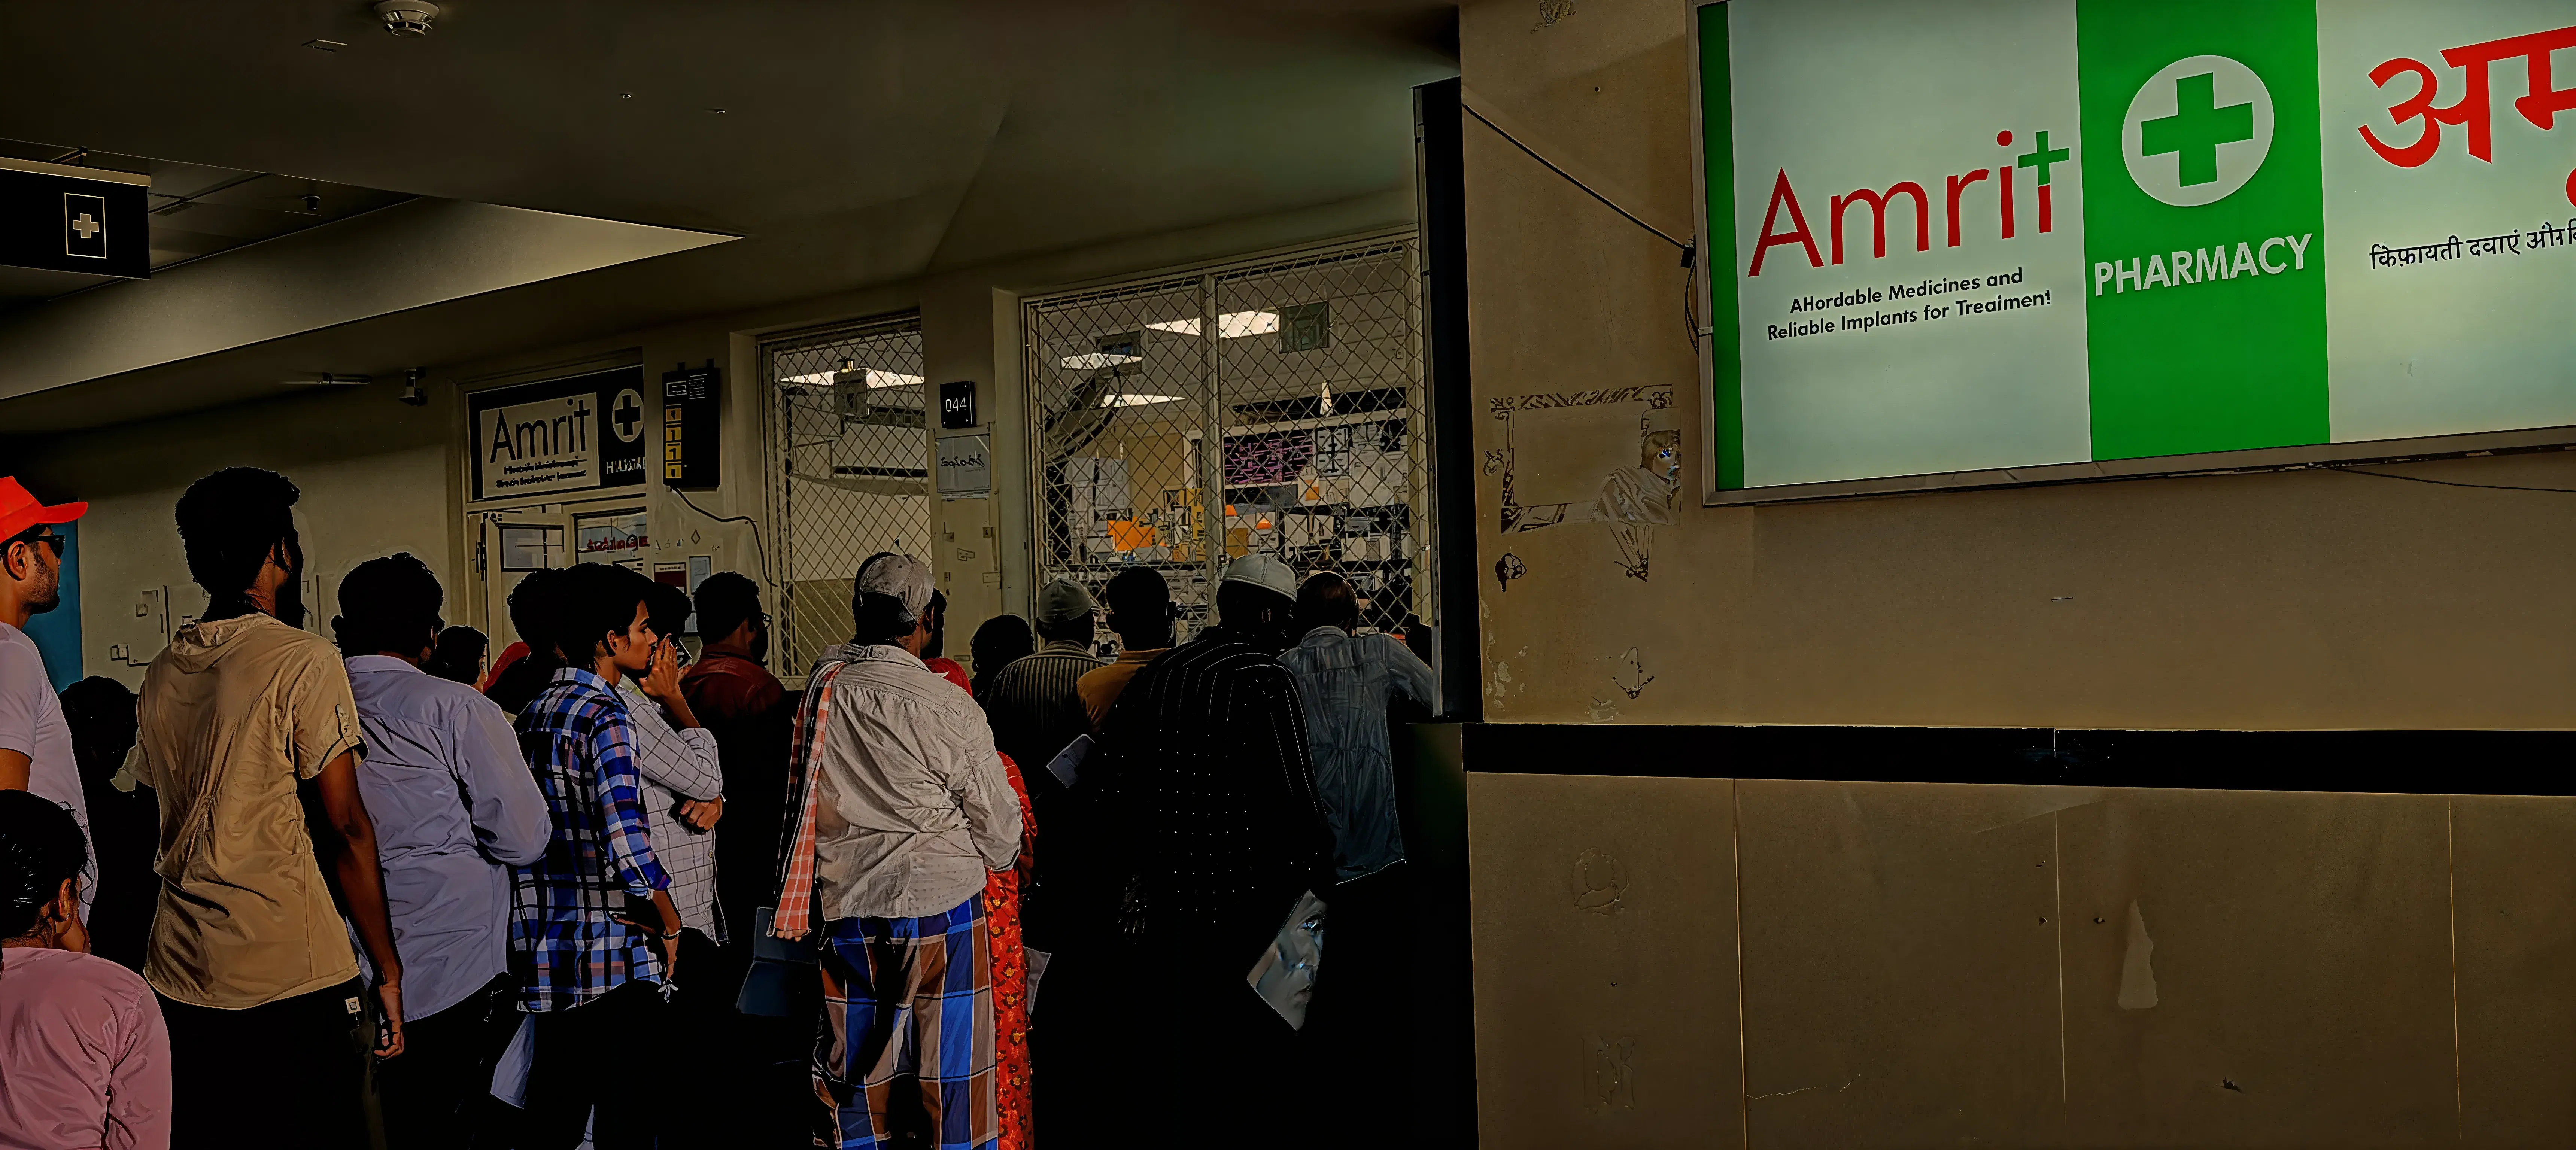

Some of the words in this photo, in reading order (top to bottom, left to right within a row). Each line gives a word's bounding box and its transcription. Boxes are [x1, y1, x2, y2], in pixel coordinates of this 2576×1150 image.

[1749, 130, 2069, 276] Amrit
[1889, 278, 1980, 301] Medicines
[1987, 267, 2022, 287] and
[2094, 233, 2312, 296] PHARMACY
[1768, 318, 1835, 340] Reliable
[1842, 310, 1917, 332] Implants
[1923, 305, 1950, 320] for
[945, 397, 967, 412] 044
[490, 398, 591, 463] Amrit
